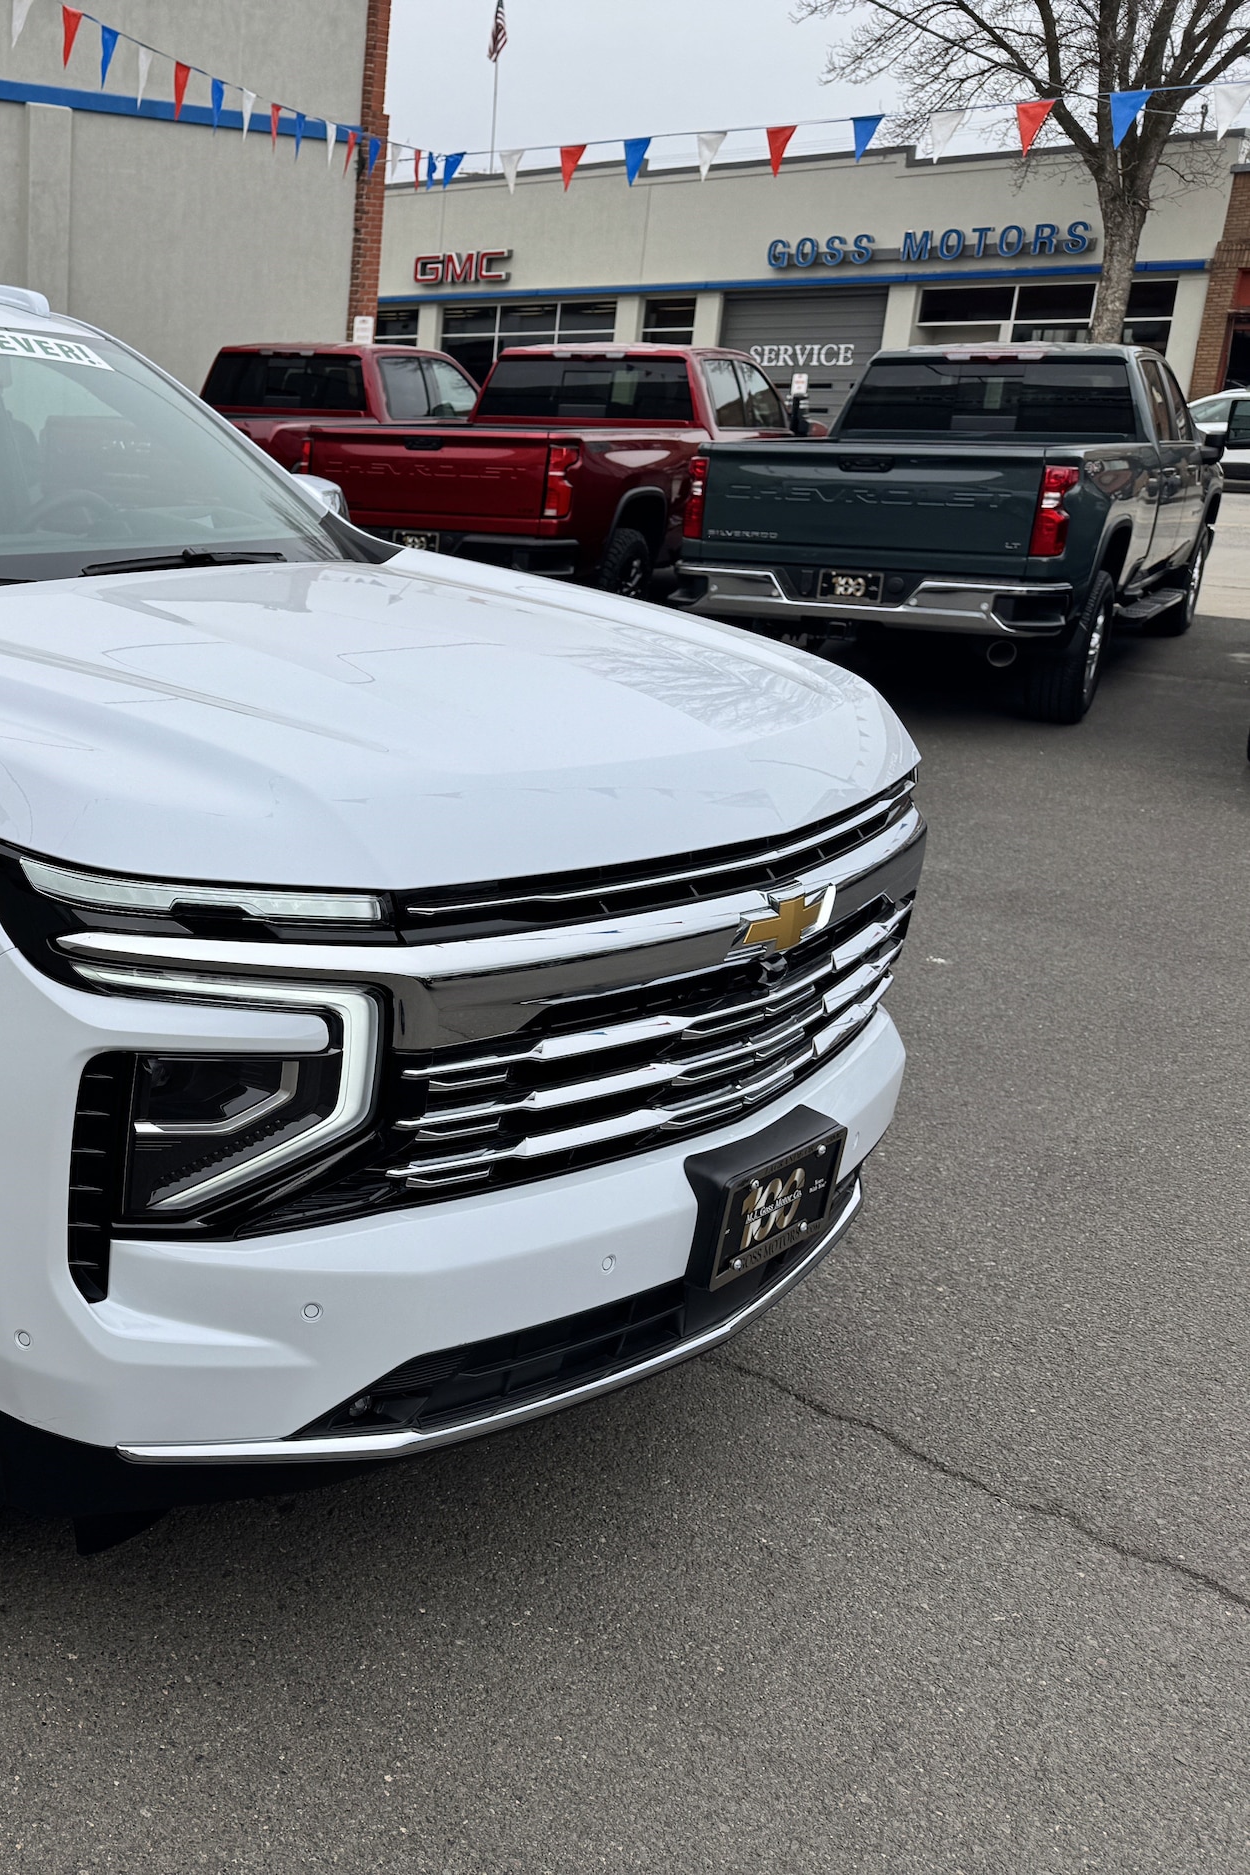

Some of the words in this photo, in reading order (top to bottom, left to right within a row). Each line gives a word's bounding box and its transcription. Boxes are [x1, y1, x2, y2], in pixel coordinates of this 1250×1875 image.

[767, 233, 875, 269] GOSS
[902, 220, 1093, 262] MOTORS
[413, 249, 511, 284] GMC
[750, 343, 855, 367] SERVICE
[724, 484, 1013, 509] CHEVROLET
[707, 528, 780, 540] SILVERADO
[739, 1167, 806, 1251] 100
